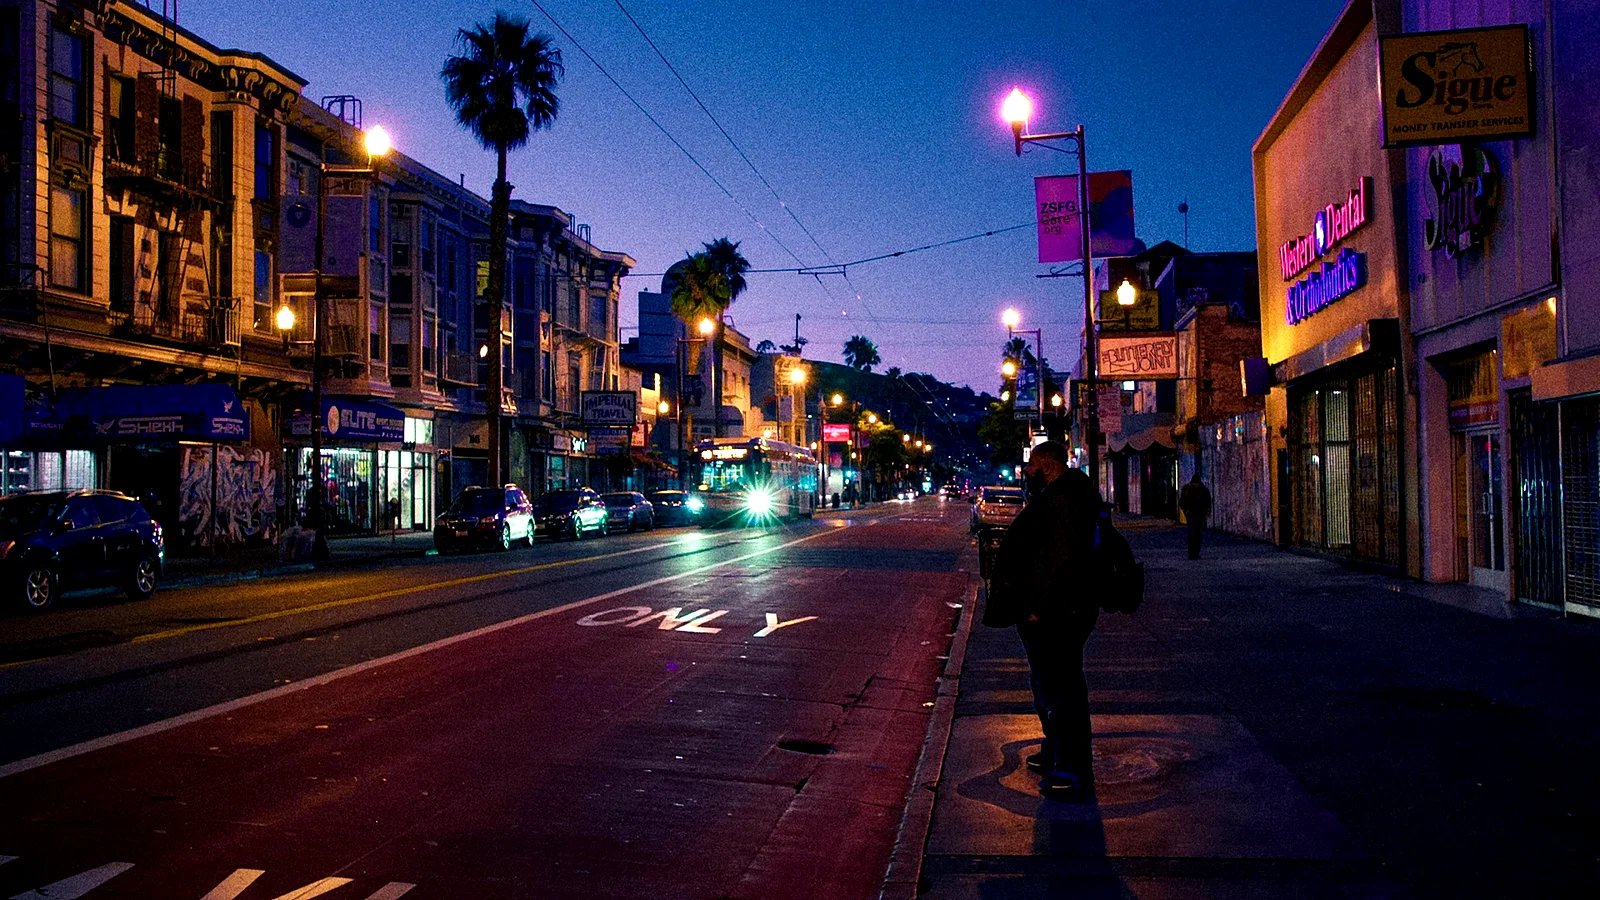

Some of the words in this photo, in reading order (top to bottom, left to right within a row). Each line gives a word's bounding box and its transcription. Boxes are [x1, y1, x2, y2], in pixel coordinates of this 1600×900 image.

[1396, 51, 1517, 115] Sigue
[1392, 122, 1428, 134] MONEY
[1431, 119, 1479, 130] TRANSFER
[1481, 115, 1525, 127] SERVICES
[1040, 201, 1076, 214] ZSFG
[1279, 231, 1316, 281] Western
[1325, 176, 1367, 250] Dental
[1295, 250, 1360, 321] Orthodontics
[584, 394, 633, 412] IMPERIAL
[591, 408, 627, 419] TRAVEL
[576, 607, 819, 638] ONLY
